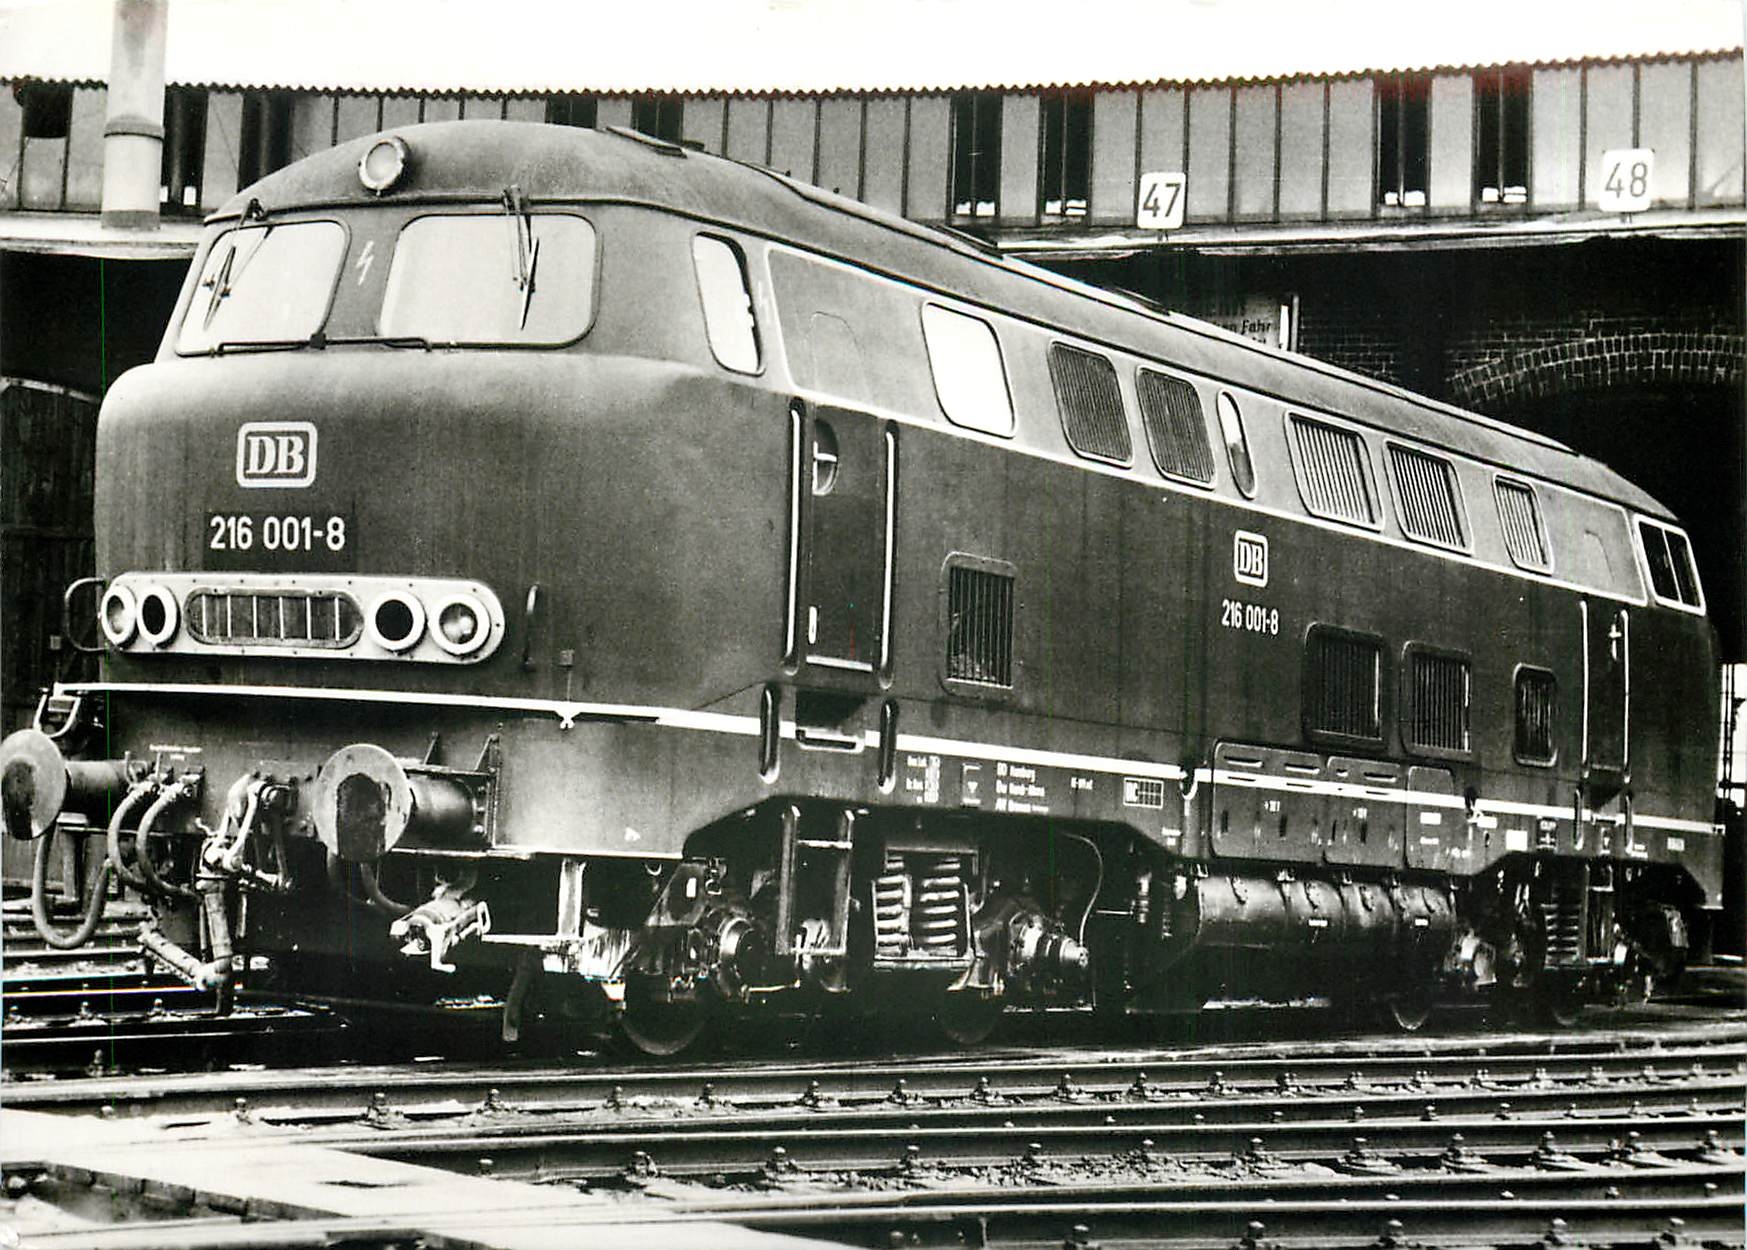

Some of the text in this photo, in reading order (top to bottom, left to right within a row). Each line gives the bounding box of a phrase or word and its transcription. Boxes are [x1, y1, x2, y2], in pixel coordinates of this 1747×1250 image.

[1605, 162, 1648, 198] 48
[1143, 183, 1181, 217] 47
[246, 436, 305, 474] DB
[210, 516, 346, 550] 216 001-8
[1239, 541, 1263, 576] DB
[1222, 599, 1279, 635] 216 001-8
